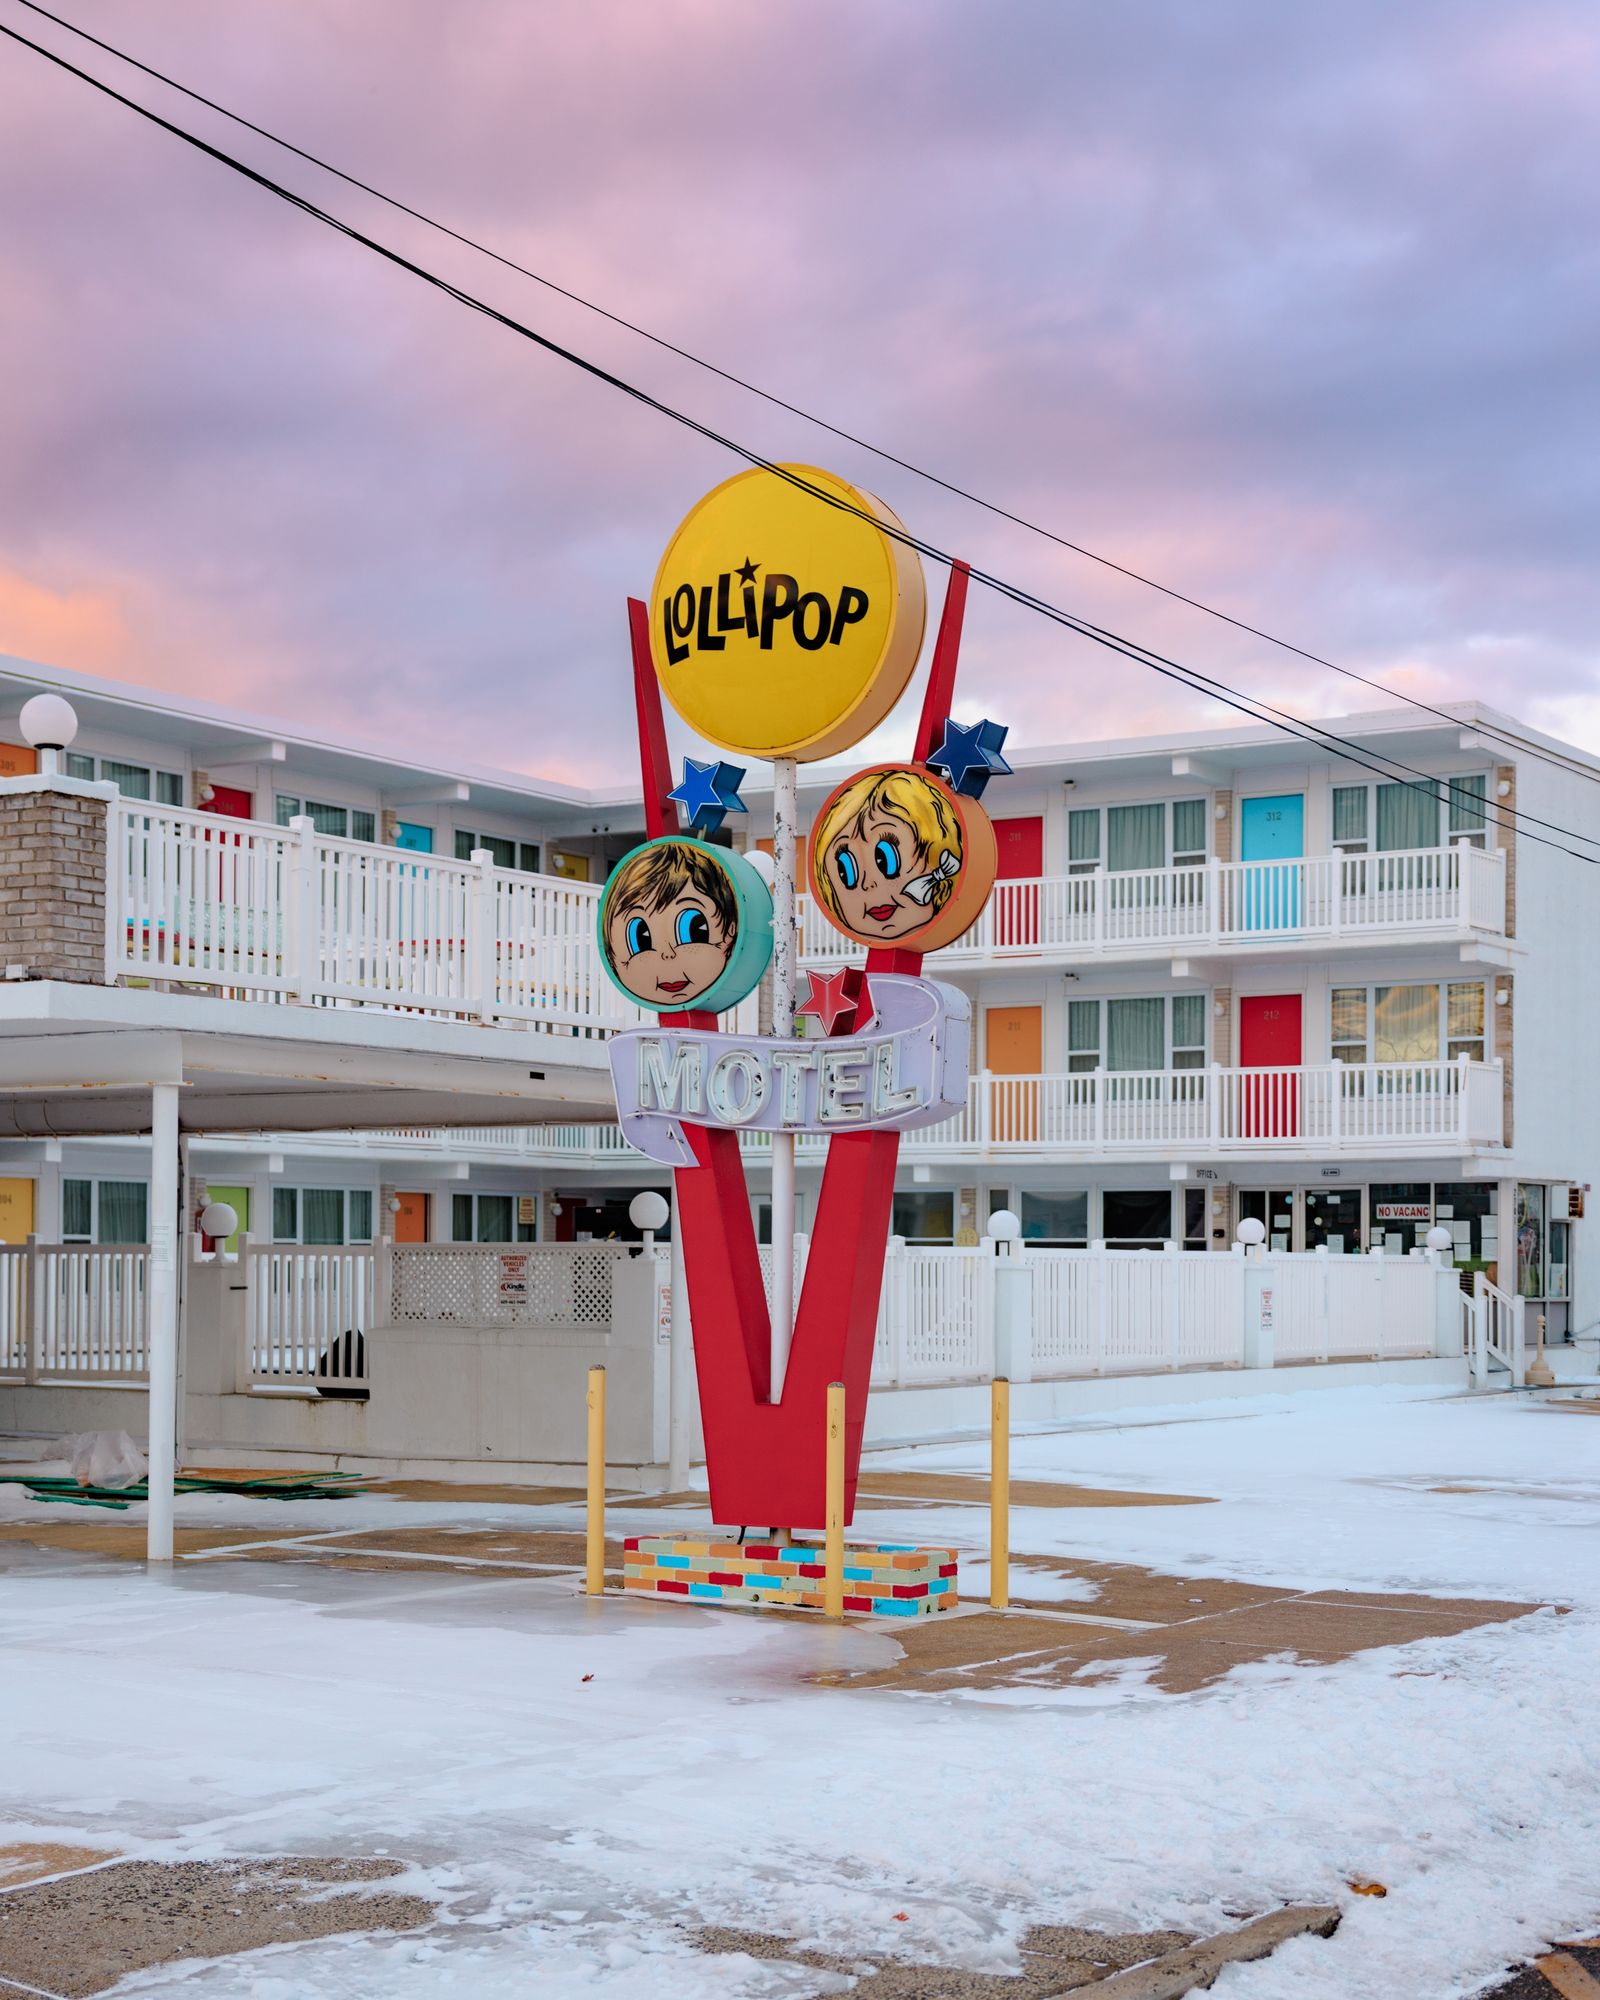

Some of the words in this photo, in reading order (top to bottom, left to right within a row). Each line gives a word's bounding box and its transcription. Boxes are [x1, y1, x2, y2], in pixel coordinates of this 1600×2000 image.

[1265, 810, 1282, 821] 312
[1263, 1009, 1280, 1020] 212
[637, 1037, 919, 1127] MOTEL
[1196, 1169, 1213, 1179] OFFICE
[1378, 1206, 1391, 1217] NO
[1392, 1206, 1430, 1217] VACANC
